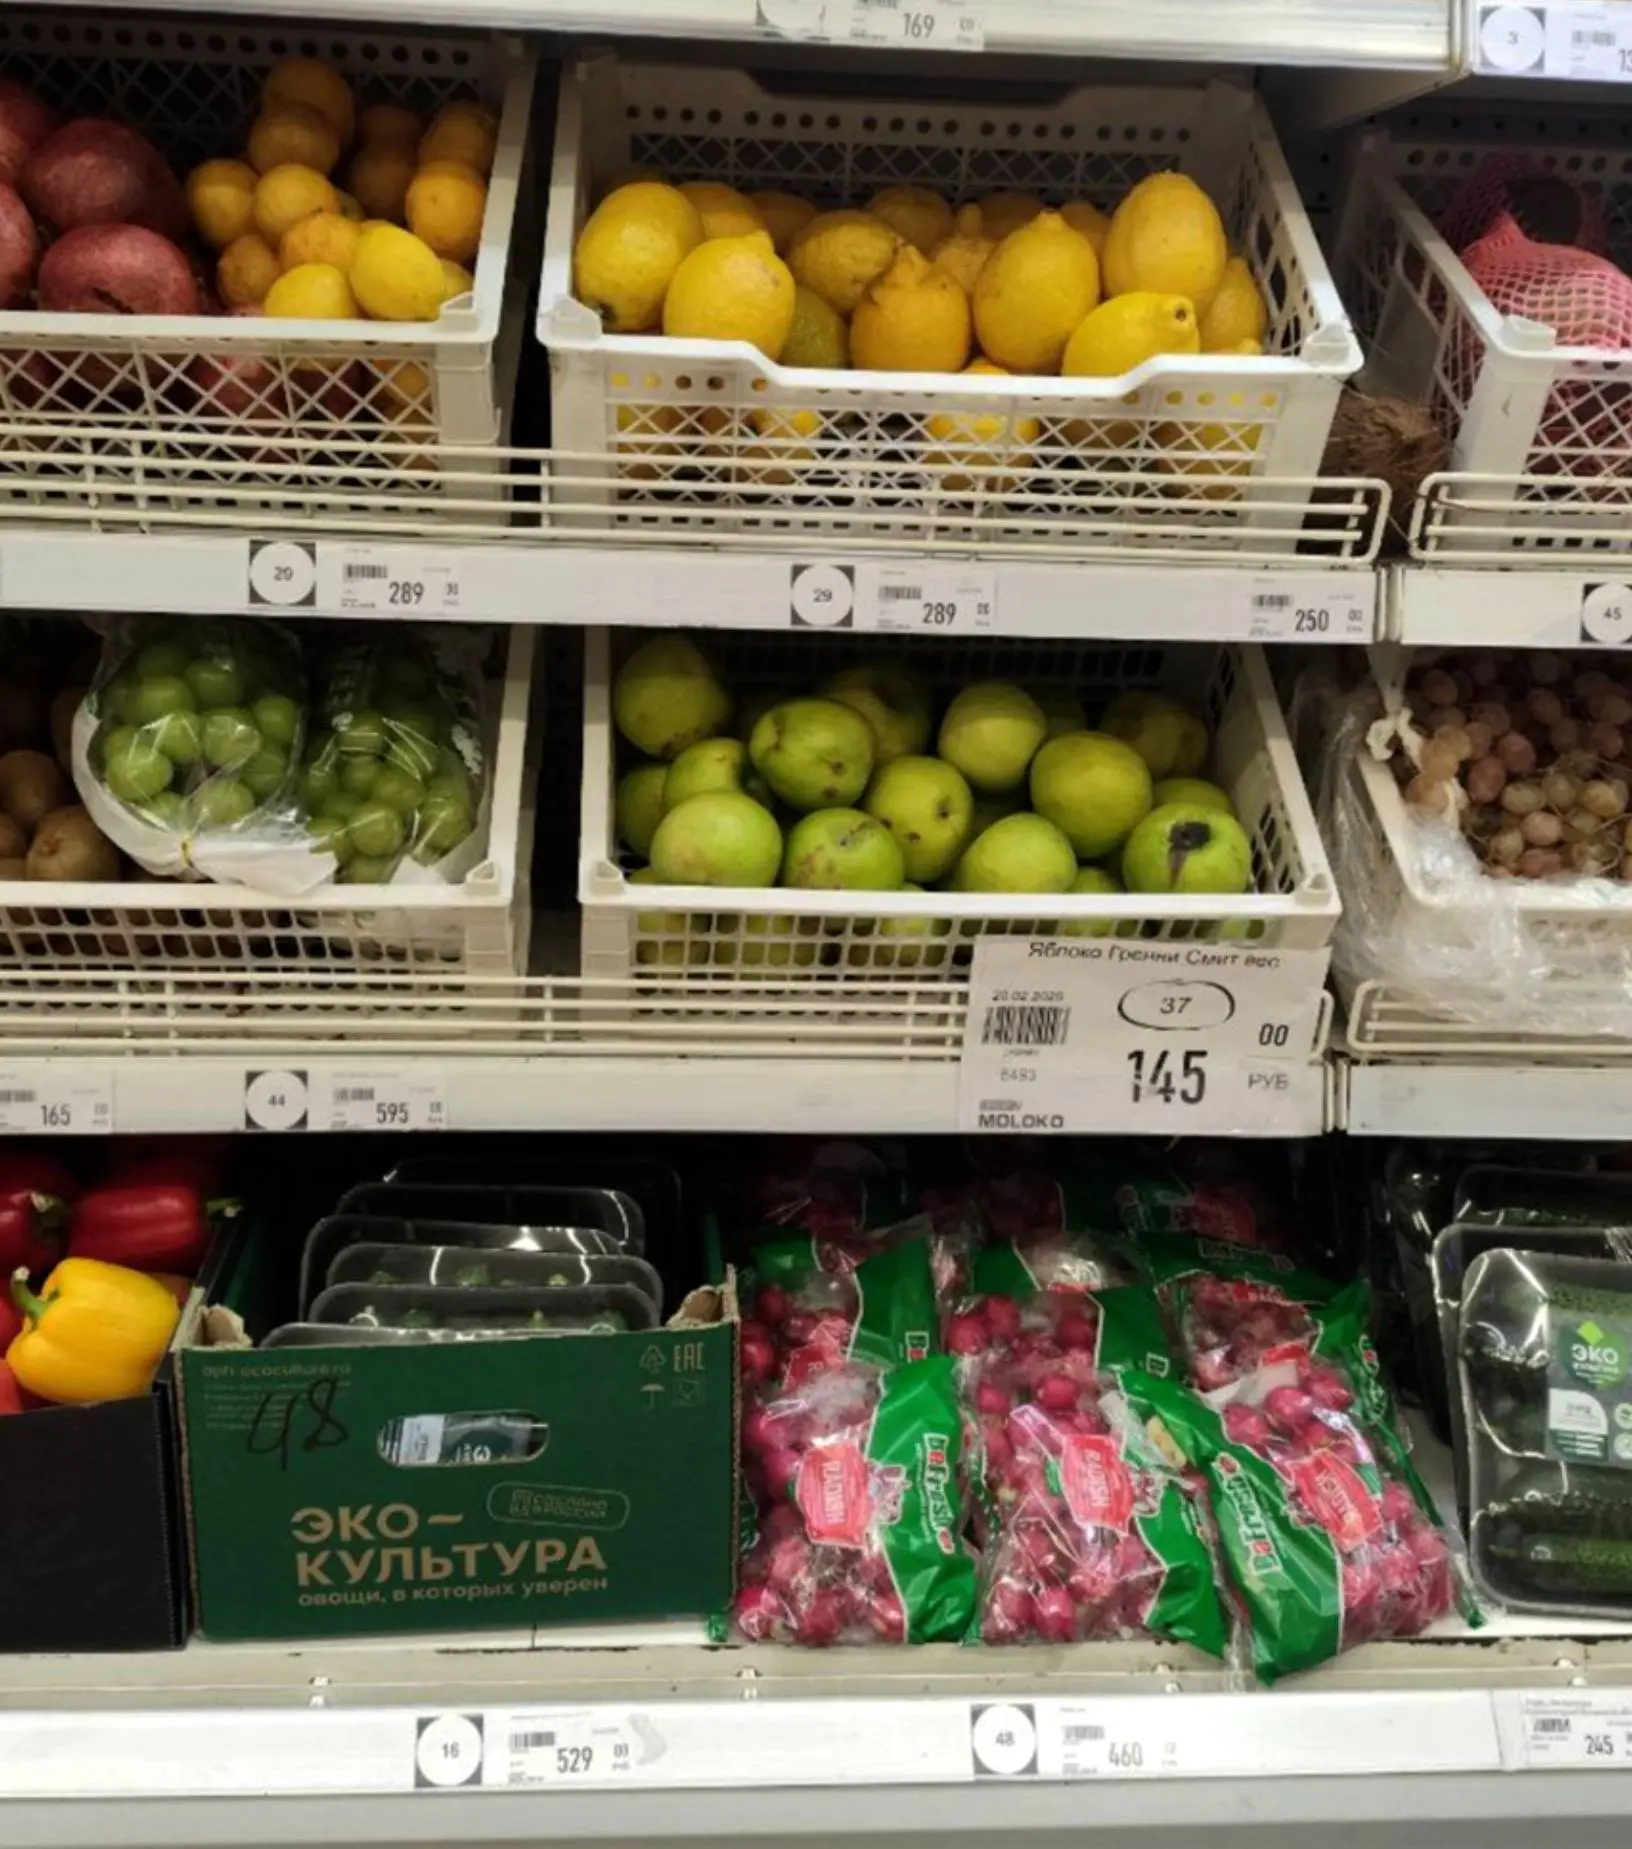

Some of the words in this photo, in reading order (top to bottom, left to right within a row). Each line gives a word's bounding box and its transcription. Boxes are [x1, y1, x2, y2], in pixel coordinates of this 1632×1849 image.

[903, 12, 935, 38] 169
[273, 566, 294, 581] 29
[388, 581, 424, 605] 289
[813, 588, 833, 603] 29
[922, 602, 957, 625] 289
[1294, 608, 1330, 632] 250
[1602, 606, 1622, 621] 45
[1028, 942, 1103, 960] Яблоко
[1108, 944, 1179, 964] Гренни
[1185, 948, 1239, 966] Смит
[1159, 997, 1193, 1014] 37
[1258, 1023, 1290, 1046] 00
[1128, 1049, 1208, 1104] 145
[1248, 1073, 1289, 1090] РУБ
[268, 1094, 286, 1107] 44
[41, 1103, 71, 1126] 165
[376, 1102, 409, 1124] 595
[978, 1113, 1064, 1129] MOLOKO
[246, 1378, 349, 1473] 48
[296, 1536, 607, 1586] КУЛЬТУРА
[298, 1589, 387, 1606] овощи,
[392, 1586, 406, 1601] в
[412, 1580, 515, 1601] которых
[522, 1577, 608, 1599] уверен
[442, 1742, 460, 1758] 16
[995, 1731, 1015, 1746] 48
[1585, 1734, 1614, 1756] 245
[557, 1746, 593, 1773] 529
[1109, 1742, 1143, 1767] 460
